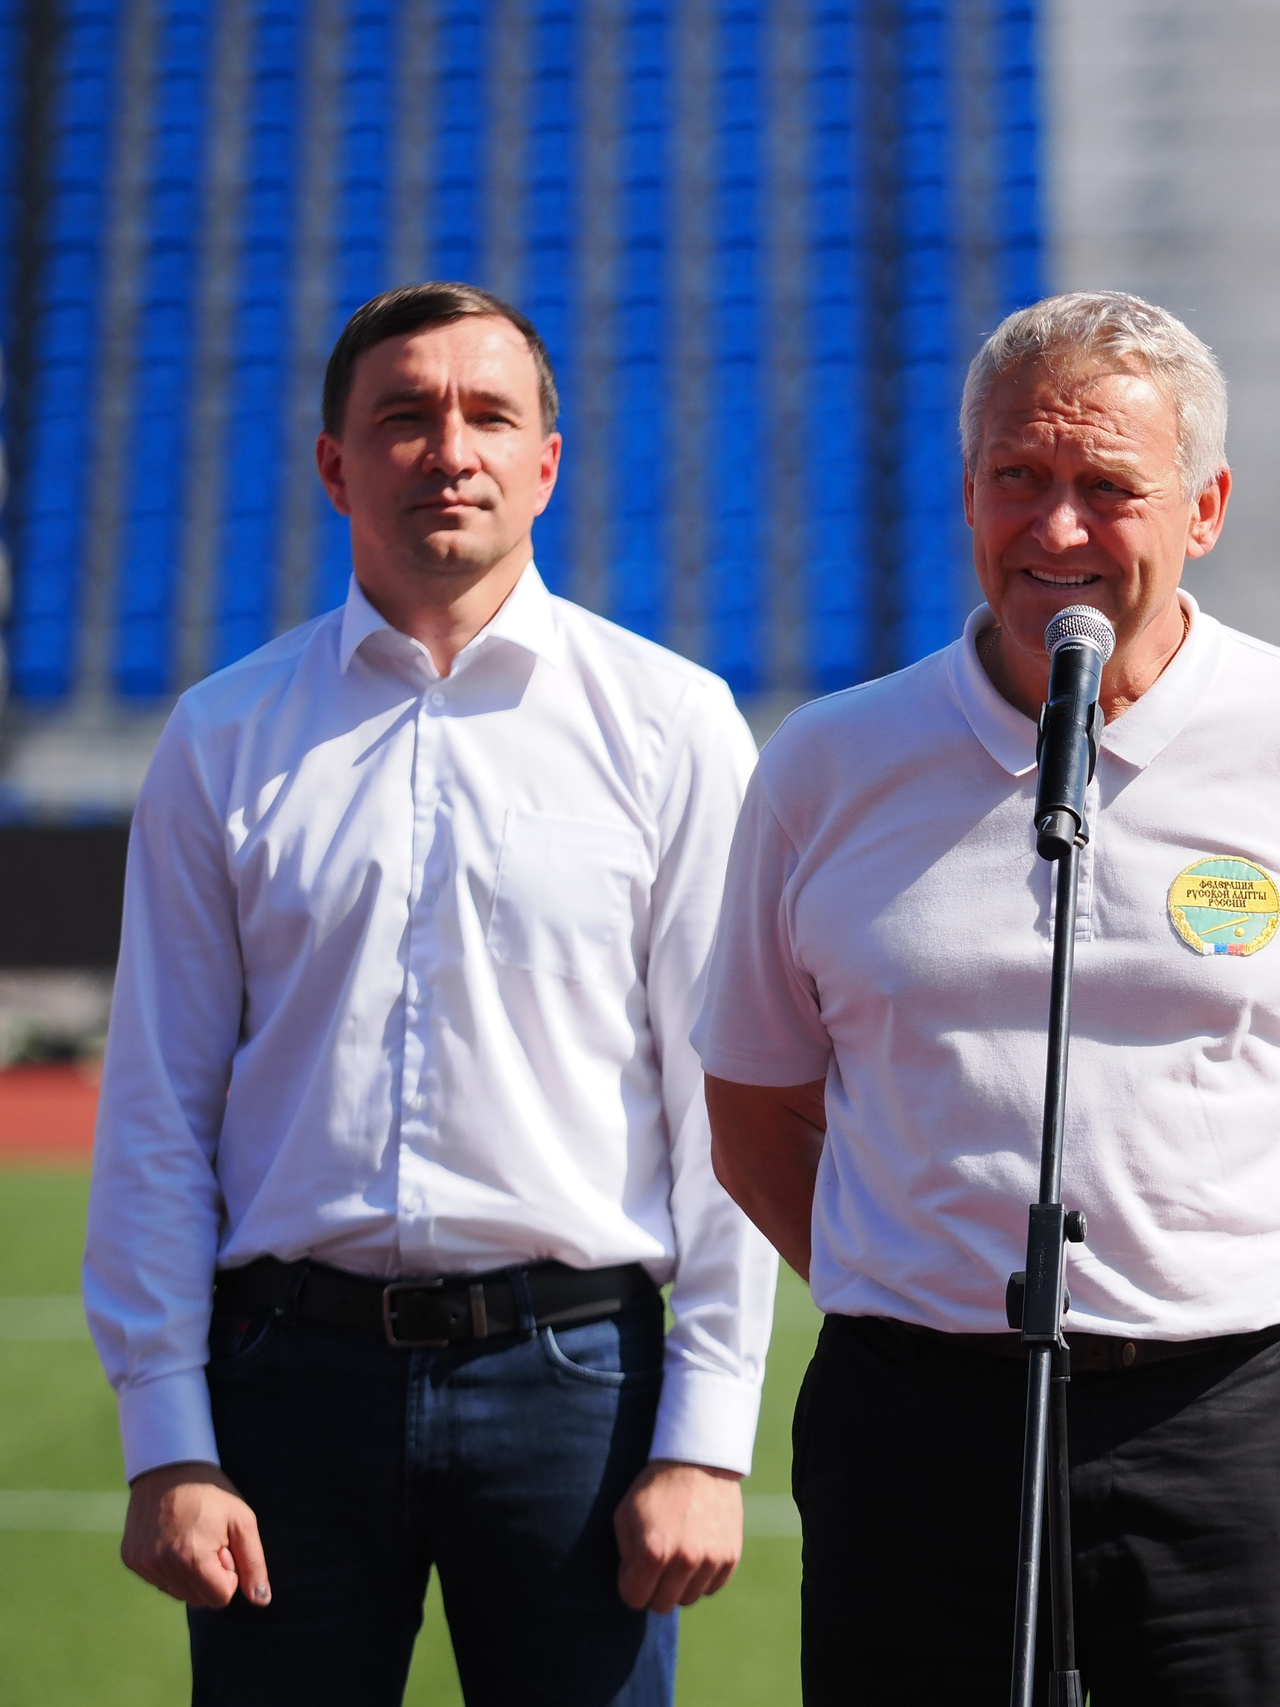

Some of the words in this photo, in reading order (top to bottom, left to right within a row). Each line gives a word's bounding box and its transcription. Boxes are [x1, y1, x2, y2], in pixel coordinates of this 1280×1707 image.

[1199, 880, 1254, 890] ФЕДЕРАЦИЯ
[1186, 889, 1230, 900] РУССКОЙ
[1232, 890, 1267, 900] ЛАПТЫ
[1208, 898, 1246, 907] РОССИИ
